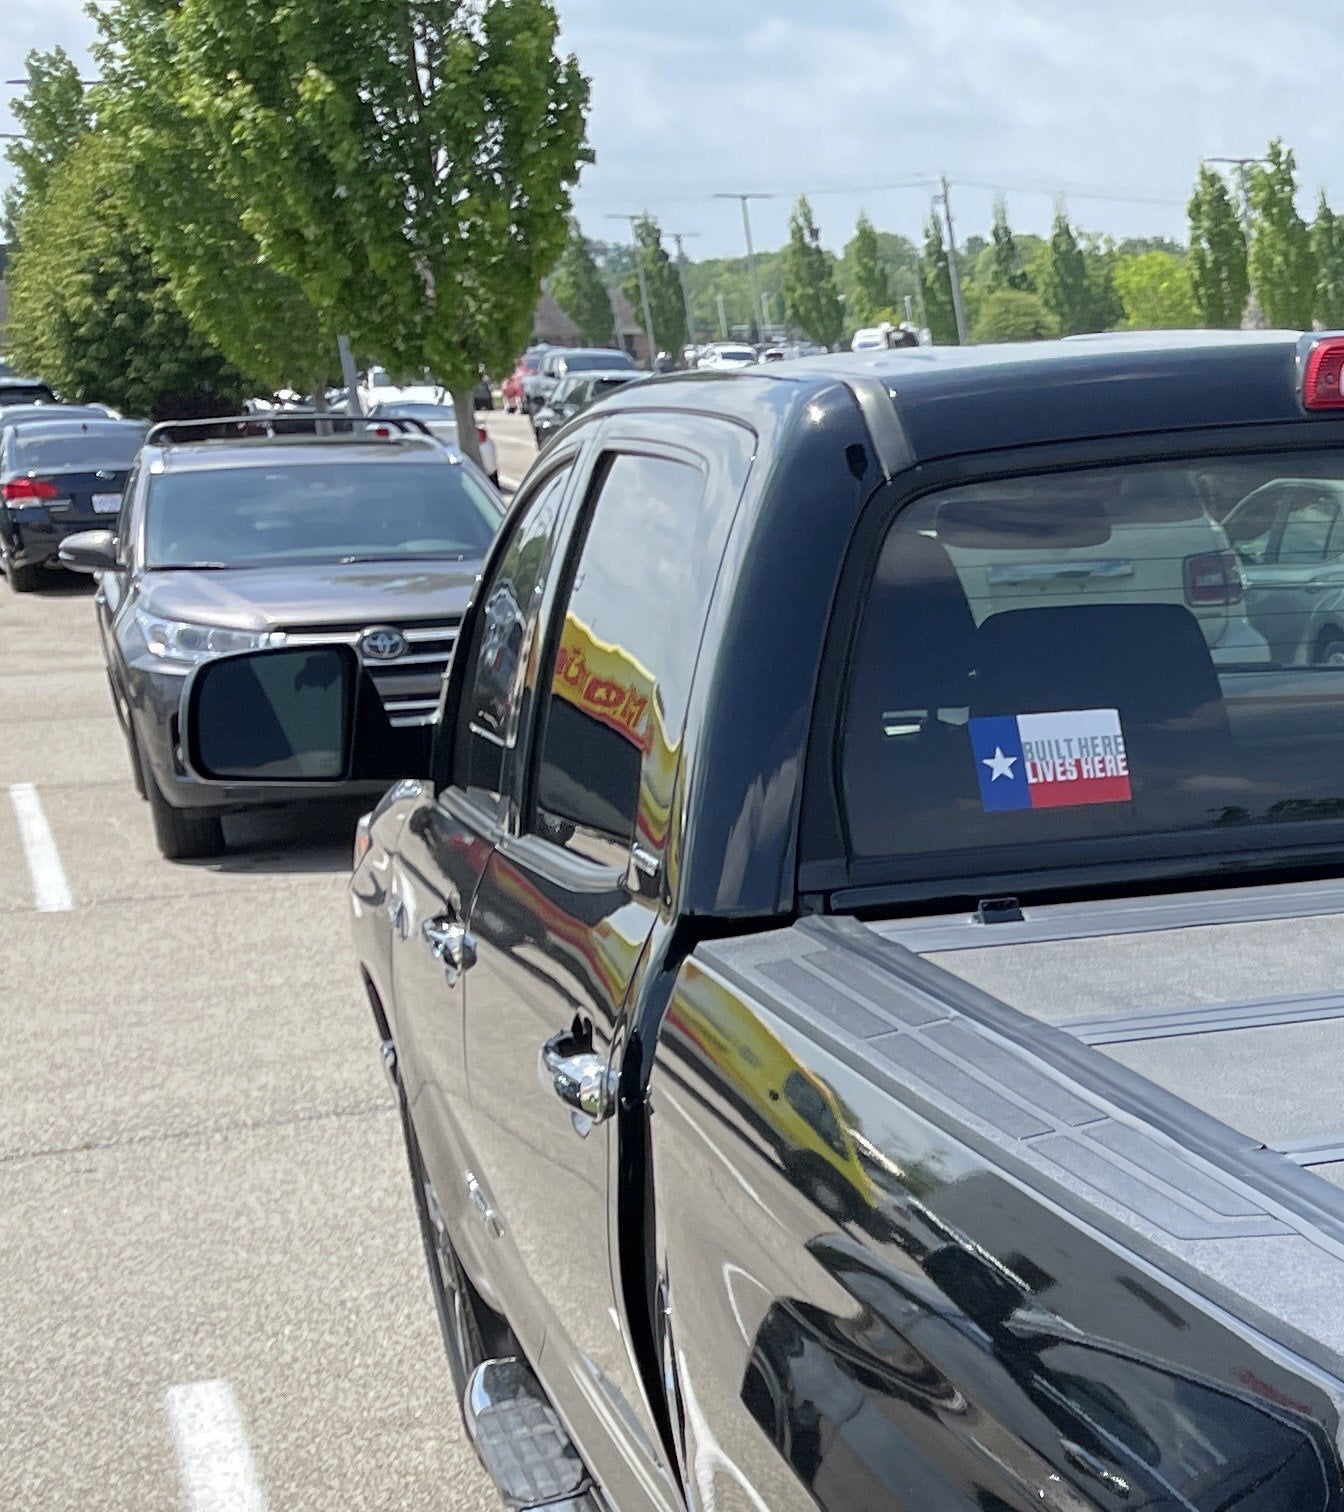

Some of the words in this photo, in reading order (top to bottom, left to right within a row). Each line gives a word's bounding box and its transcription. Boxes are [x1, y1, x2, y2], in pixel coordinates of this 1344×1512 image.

[1023, 738, 1074, 762] BUILT
[1078, 734, 1126, 759] HERE
[1025, 759, 1079, 784] LIVES
[1082, 754, 1130, 779] HERE
